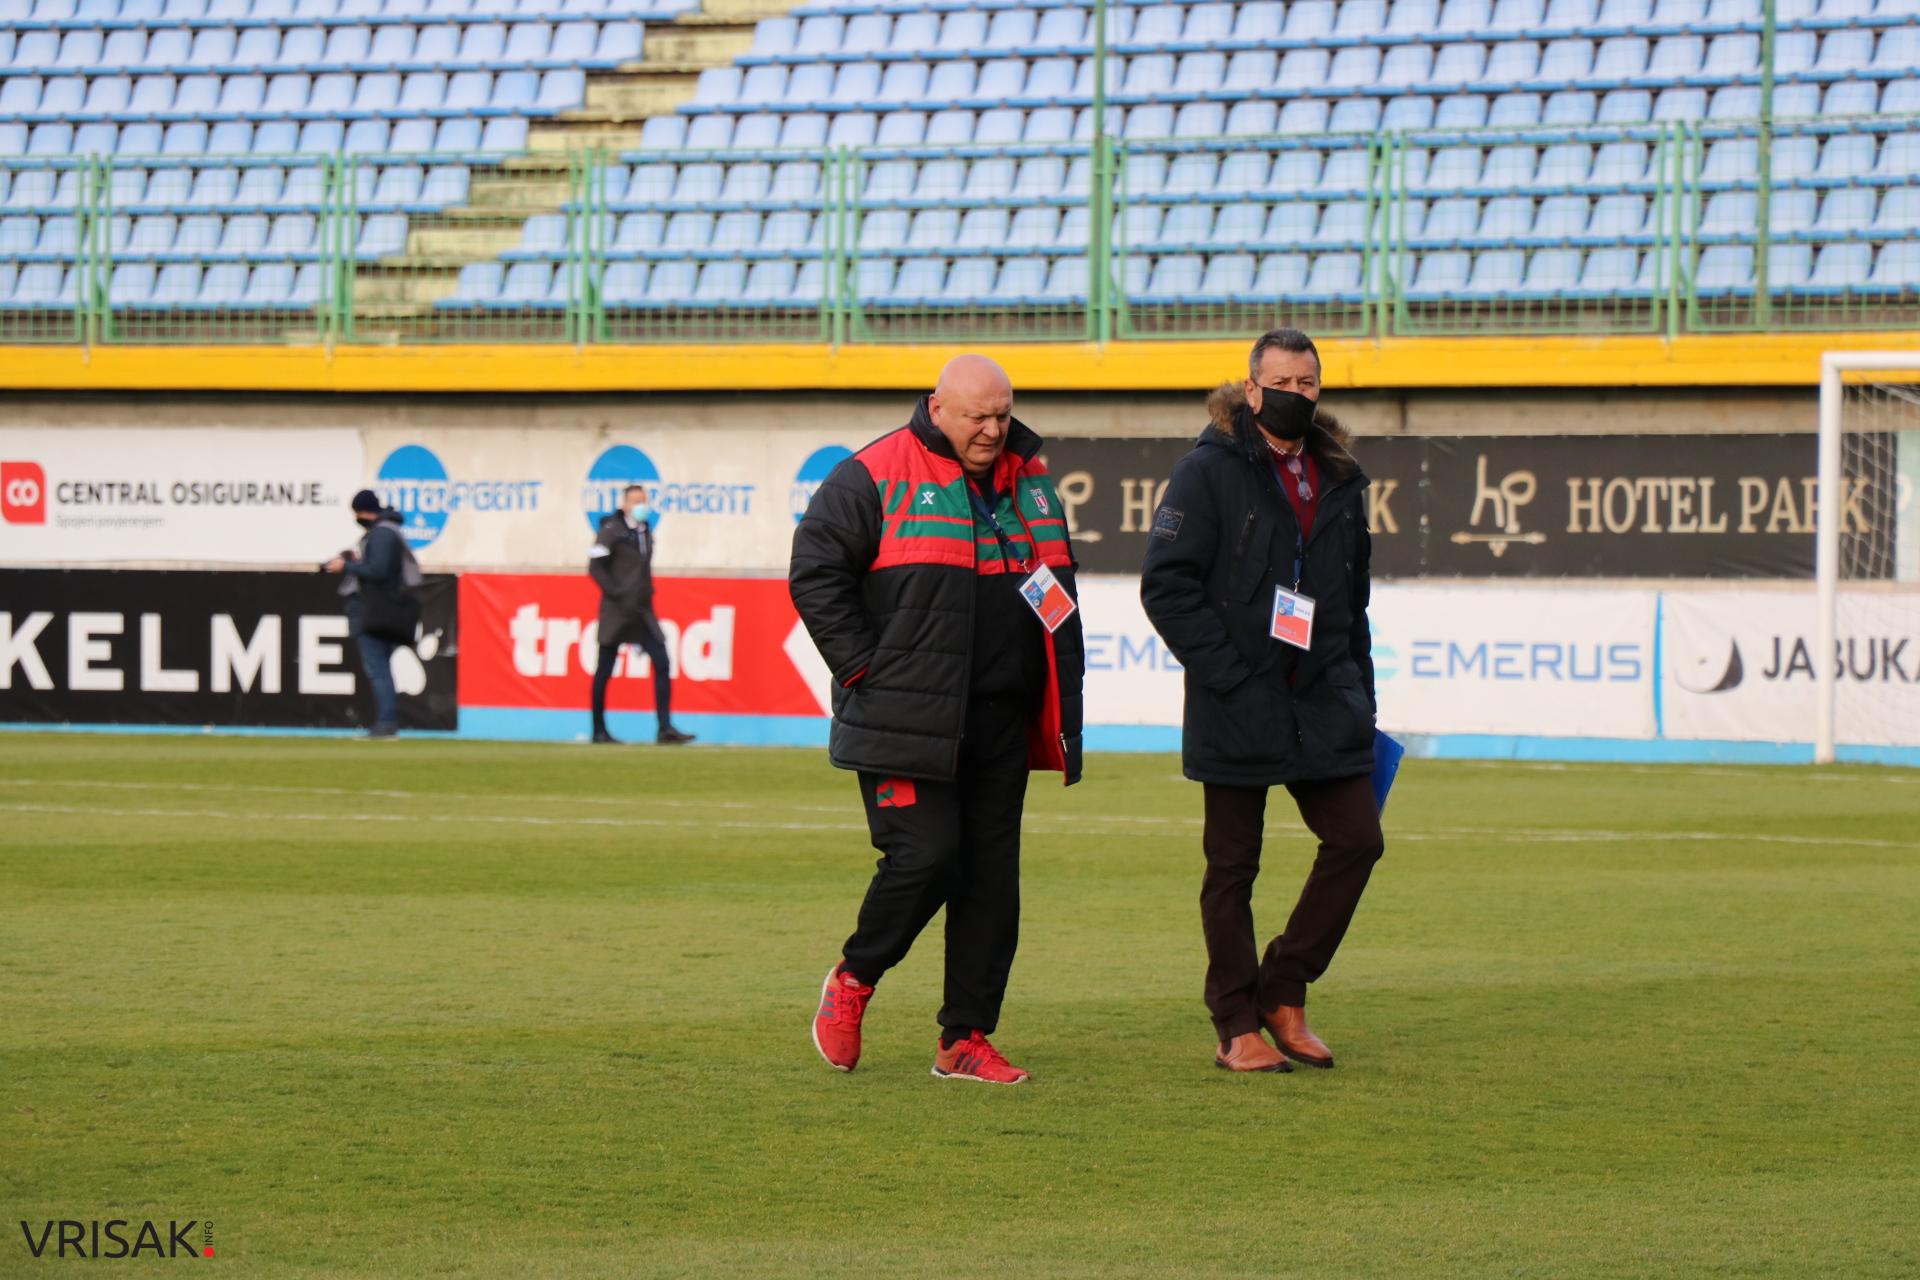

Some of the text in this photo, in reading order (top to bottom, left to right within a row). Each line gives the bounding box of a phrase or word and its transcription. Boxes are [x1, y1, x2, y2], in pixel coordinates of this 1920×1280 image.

[56, 482, 162, 505] CENTRAL
[171, 482, 322, 505] OSIGURANJE
[1566, 477, 1728, 533] HOTEL
[0, 611, 355, 694] KELME
[1411, 641, 1641, 681] EMERUS
[1763, 636, 1920, 682] JAUK
